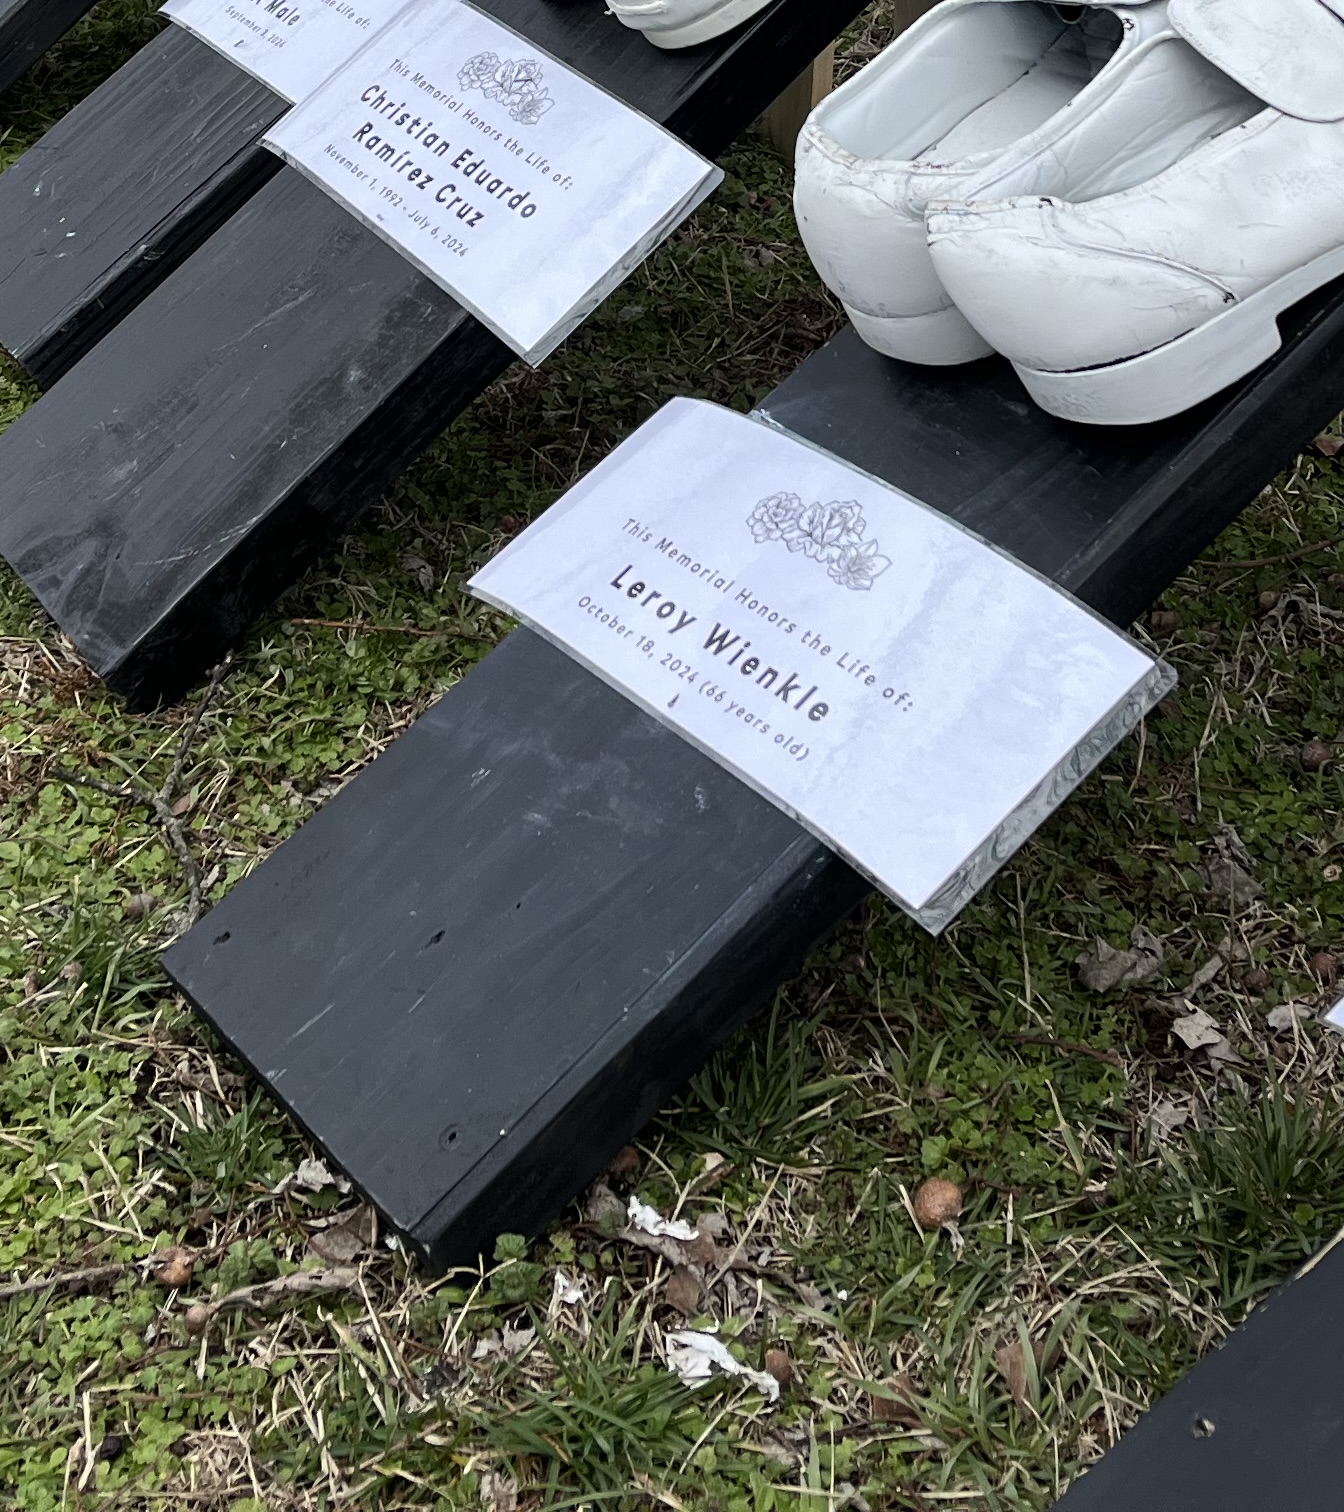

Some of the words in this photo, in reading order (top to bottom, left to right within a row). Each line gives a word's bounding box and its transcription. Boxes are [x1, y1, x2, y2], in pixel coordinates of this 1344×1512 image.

[225, 5, 262, 33] September
[335, 2, 355, 20] Life
[355, 17, 370, 30] of:
[352, 121, 435, 190] Ramírez
[434, 183, 485, 228] Cruz
[360, 84, 450, 157] Christian
[450, 148, 537, 218] Eduardo
[389, 58, 411, 77] This
[410, 72, 464, 113] Memorial
[461, 108, 503, 141] Honors
[503, 137, 524, 156] the
[524, 151, 550, 175] Life
[552, 173, 573, 190] of:
[323, 143, 369, 181] November
[378, 186, 403, 207] 1992
[407, 209, 431, 230] July
[430, 225, 441, 240] 6,
[441, 234, 469, 257] 2024
[578, 596, 634, 639] October
[635, 635, 655, 659] 18,
[659, 652, 700, 684] 2024
[698, 680, 727, 703] (66
[723, 700, 771, 734] years
[773, 733, 810, 762] old)
[610, 564, 698, 634] Leroy
[703, 622, 829, 722] Wienkle
[622, 518, 653, 543] This
[654, 537, 736, 593] Memorial
[734, 587, 797, 634] Honors
[800, 629, 832, 657] the
[836, 651, 876, 686] Life
[882, 687, 913, 712] of:
